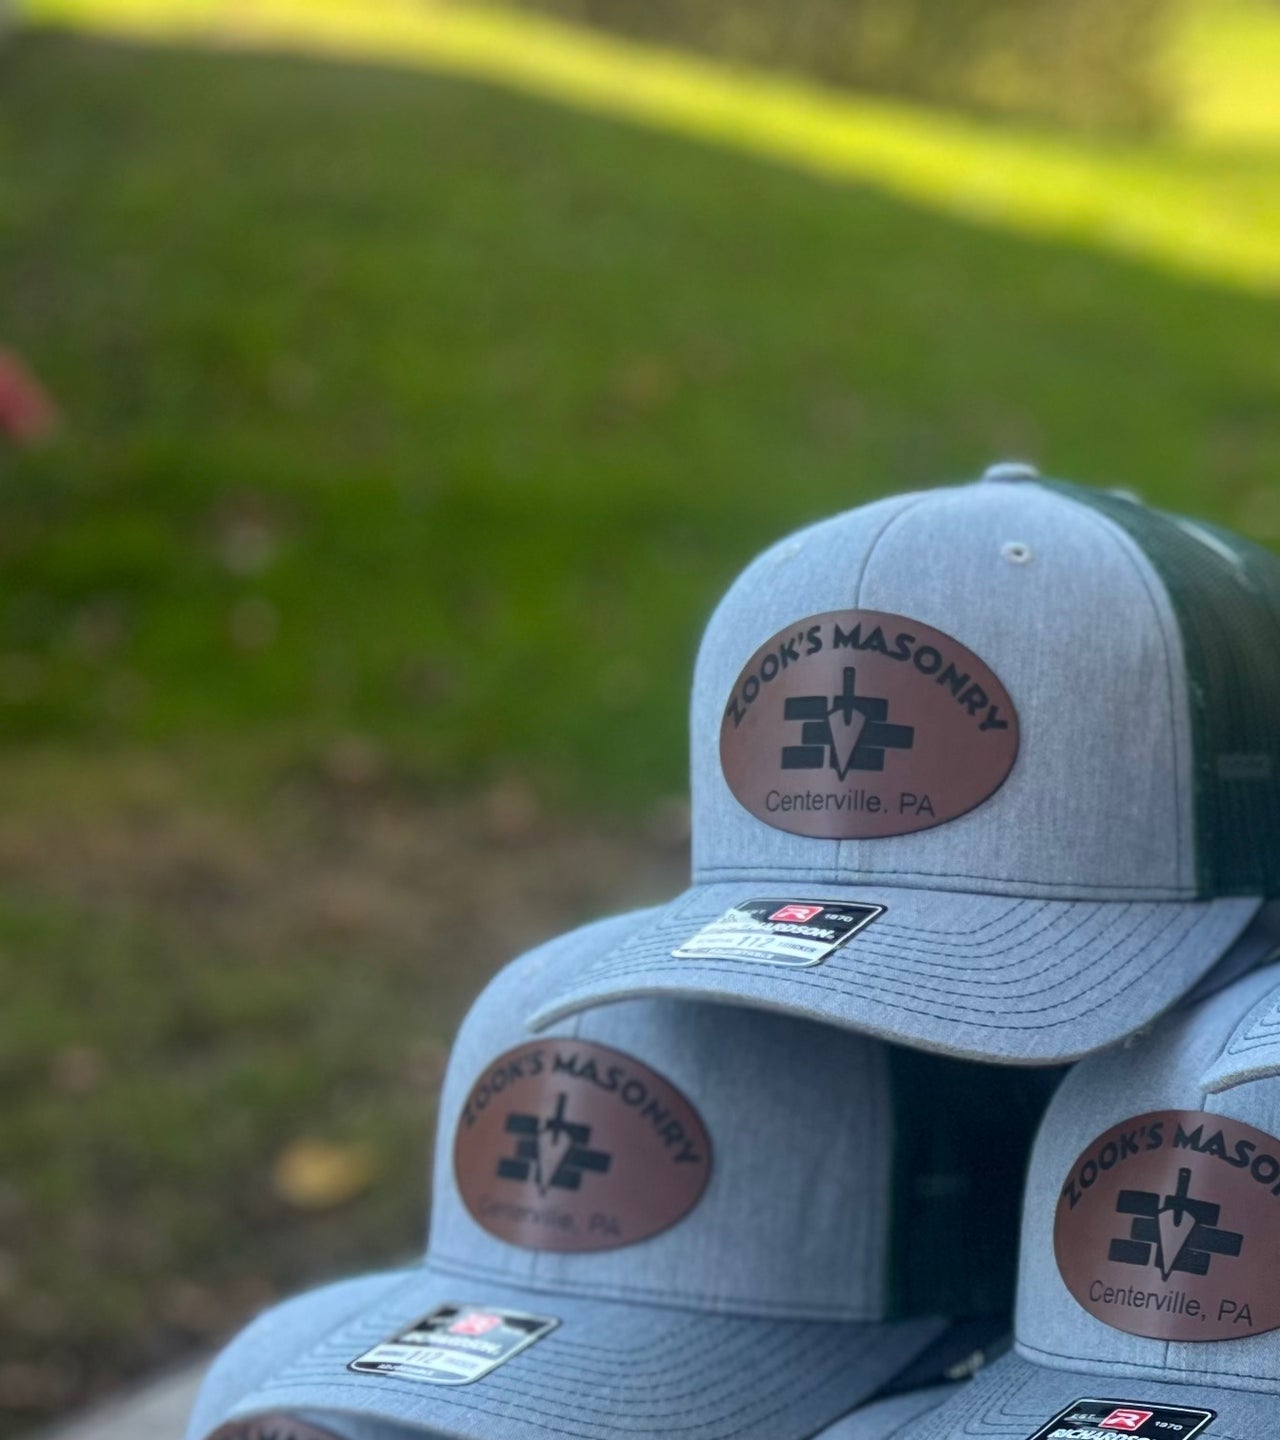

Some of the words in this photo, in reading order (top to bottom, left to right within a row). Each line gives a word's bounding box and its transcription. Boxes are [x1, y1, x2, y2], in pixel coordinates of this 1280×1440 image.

[727, 625, 823, 728] ZOOK'S
[832, 622, 1008, 732] MASONRY
[900, 793, 935, 817] PA
[737, 936, 776, 948] 112
[552, 1054, 700, 1163] MASONRY
[1063, 1122, 1163, 1210] ZOOK'S
[1089, 1280, 1206, 1321] Centerville,
[1217, 1300, 1253, 1326] PA
